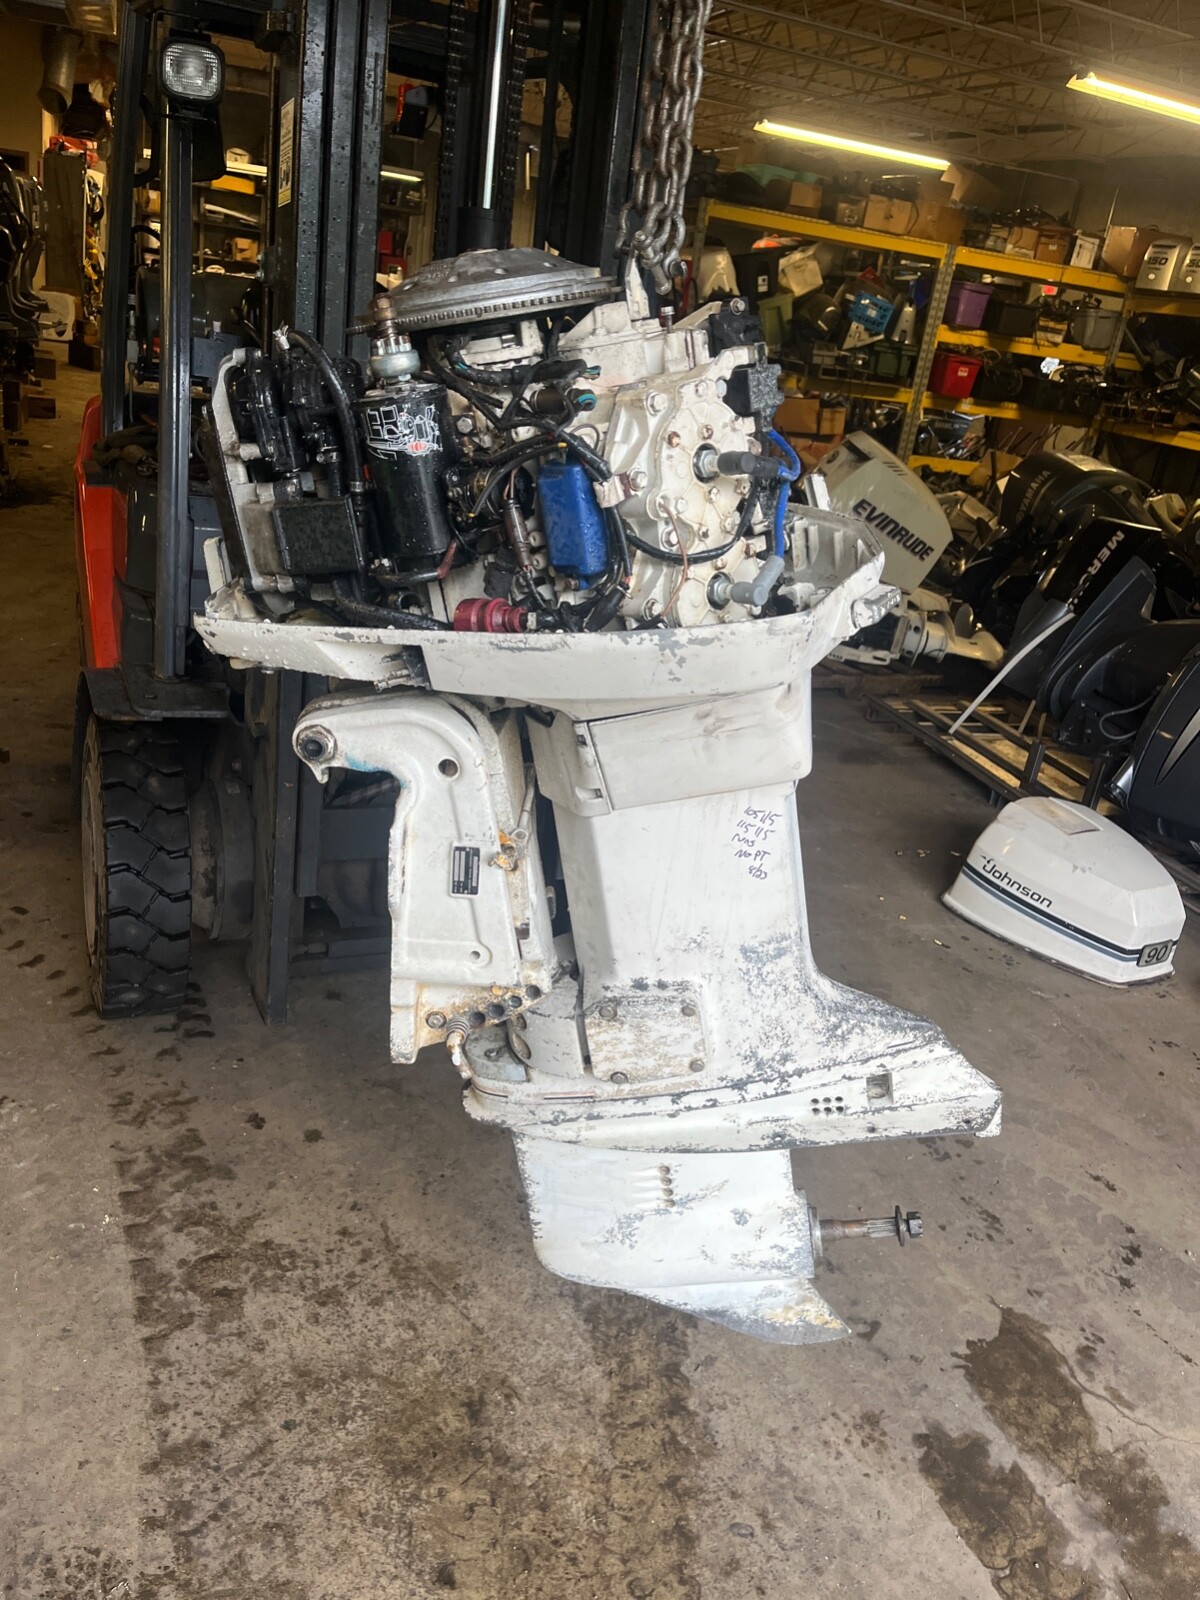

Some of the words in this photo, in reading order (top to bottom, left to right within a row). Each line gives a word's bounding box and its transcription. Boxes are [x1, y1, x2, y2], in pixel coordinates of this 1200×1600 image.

[1020, 470, 1051, 512] YAMAHA
[852, 498, 934, 561] EVINRUDE
[982, 863, 1053, 908] Johnson
[1145, 944, 1168, 963] 90
